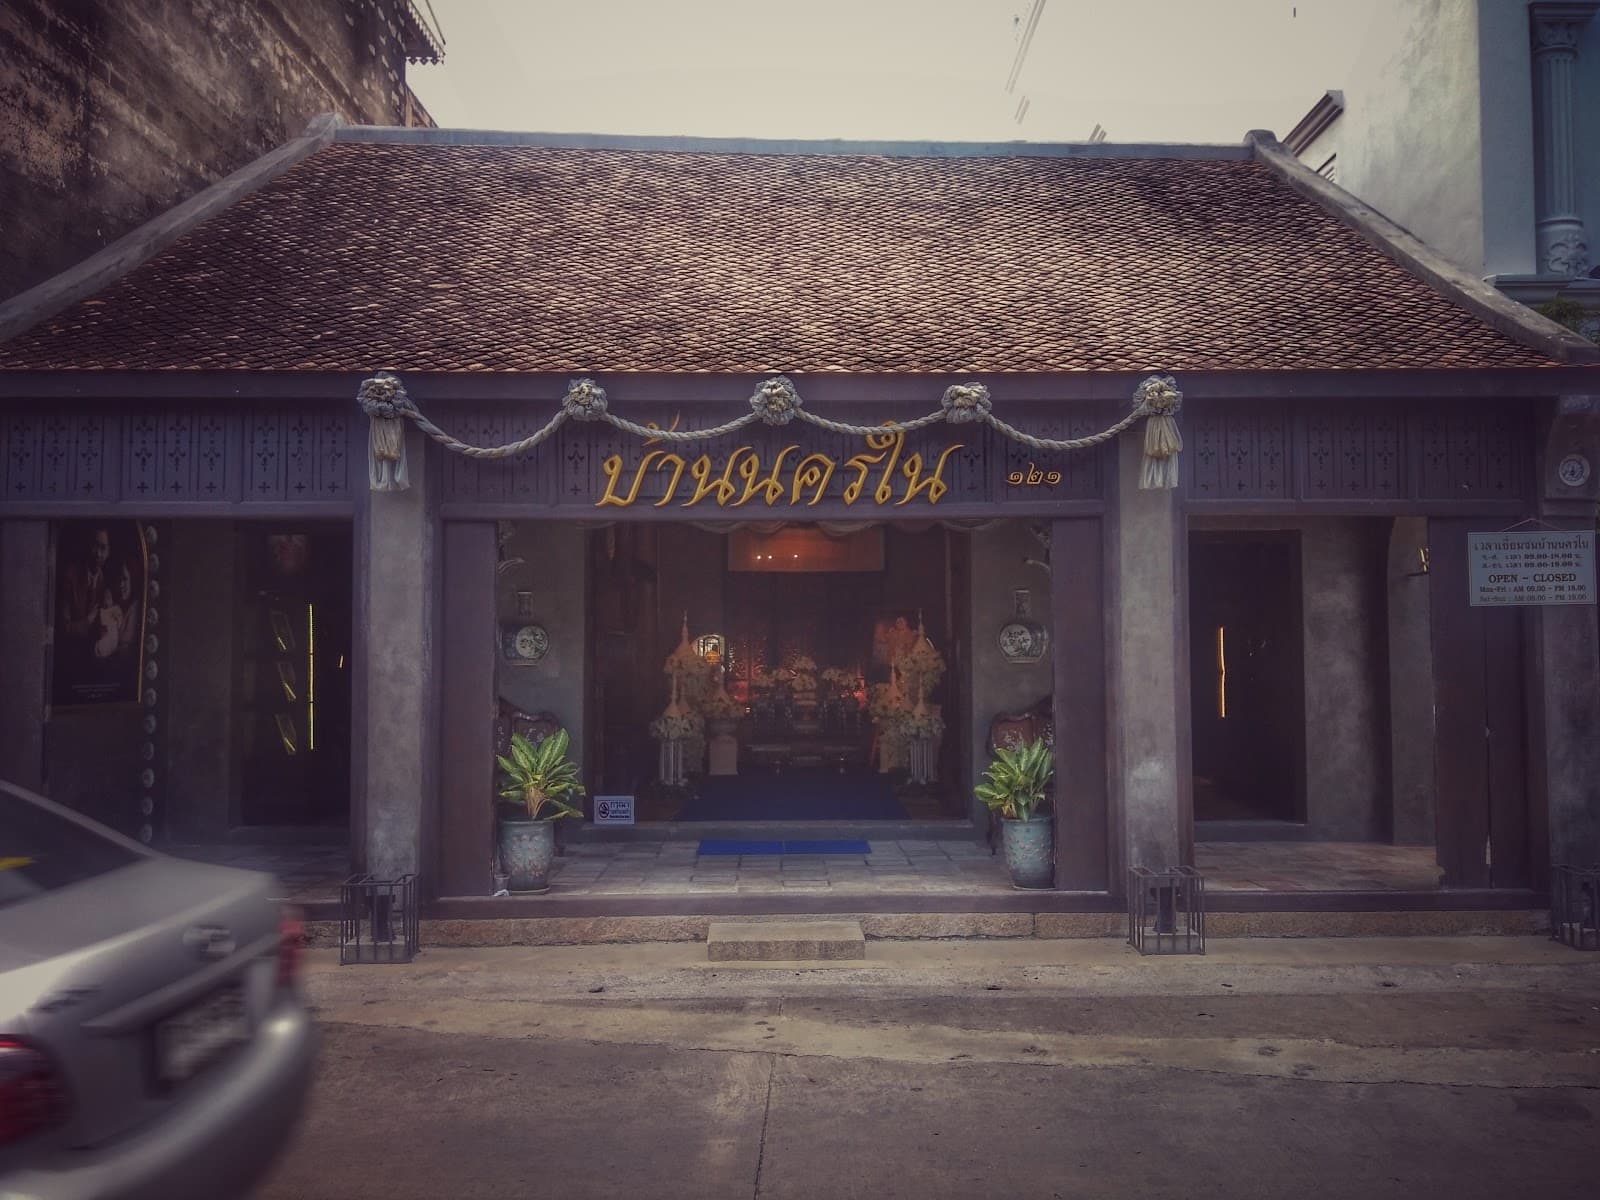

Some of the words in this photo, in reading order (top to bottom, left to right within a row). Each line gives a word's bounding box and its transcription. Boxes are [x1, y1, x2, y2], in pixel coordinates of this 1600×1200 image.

[595, 414, 964, 506] บ้านนครใน
[1006, 462, 1061, 485] ๑๒๑
[1488, 574, 1518, 584] OPEN
[1533, 573, 1577, 583] CLOSED
